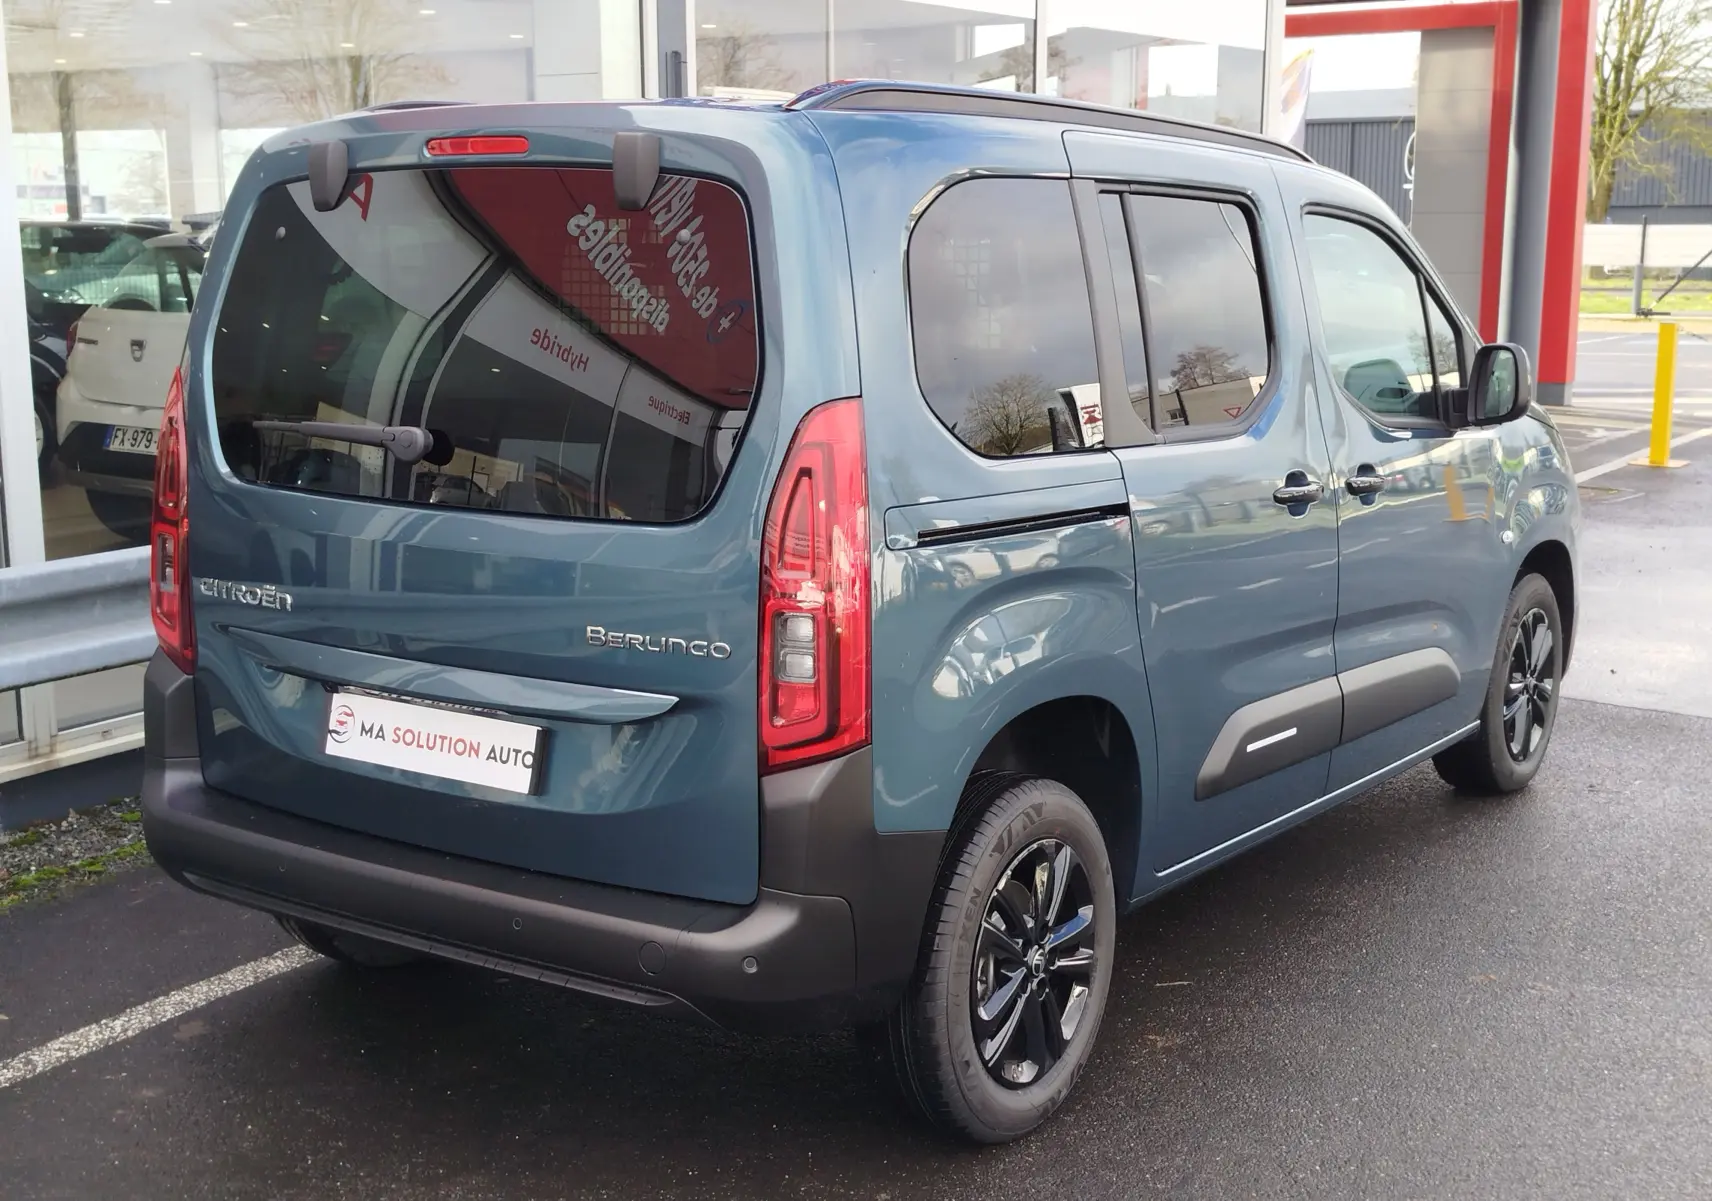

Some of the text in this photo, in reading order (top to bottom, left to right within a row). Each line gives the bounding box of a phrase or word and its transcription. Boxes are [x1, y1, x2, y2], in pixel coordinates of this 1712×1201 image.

[111, 427, 158, 449] FX-979-
[200, 577, 294, 612] CITROËN
[360, 719, 535, 769] MA SOLUTION AUTO
